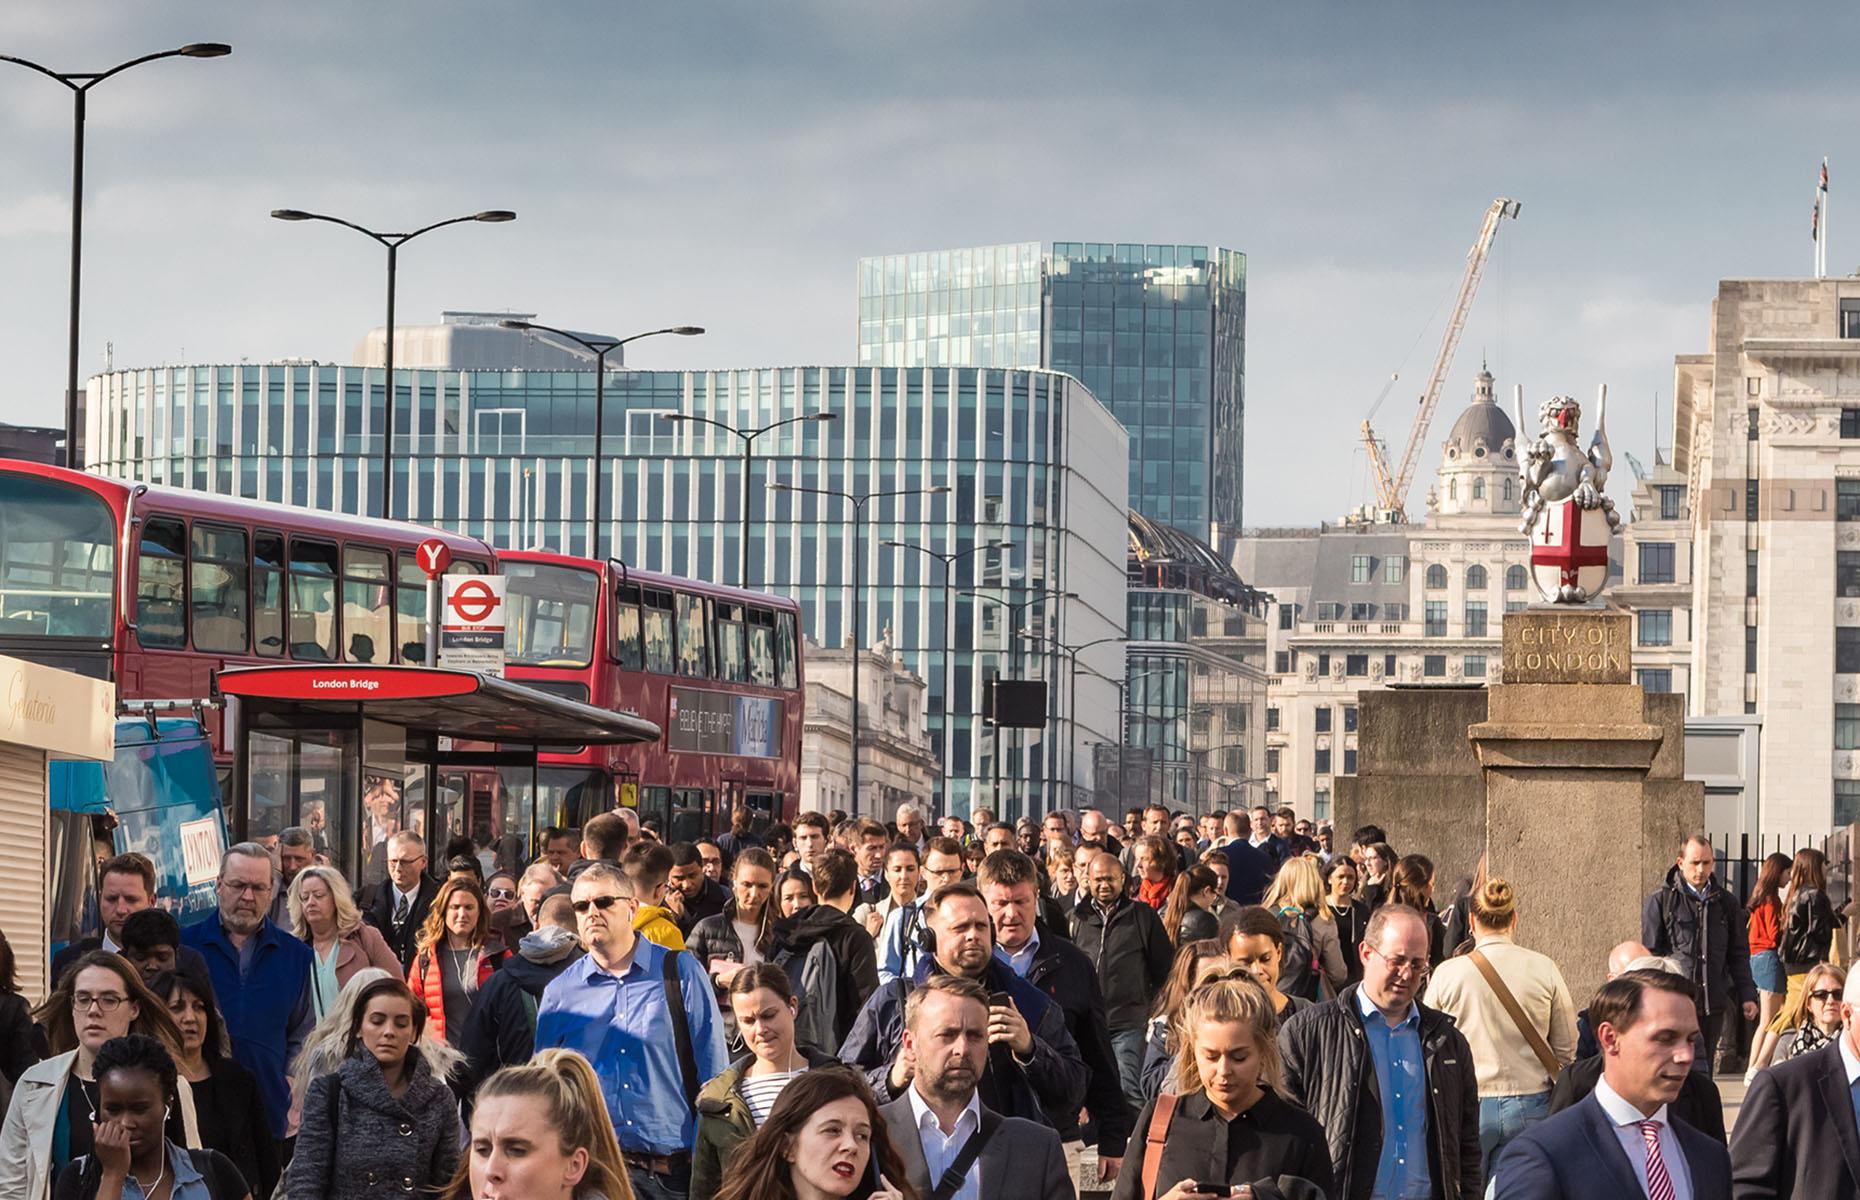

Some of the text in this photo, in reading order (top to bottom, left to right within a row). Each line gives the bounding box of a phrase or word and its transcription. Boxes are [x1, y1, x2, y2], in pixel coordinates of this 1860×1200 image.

[422, 544, 444, 570] Y
[475, 636, 493, 644] Bridge
[1522, 627, 1618, 645] CITY OF
[1514, 652, 1622, 671] LONDON
[312, 679, 379, 691] London Bridge
[8, 670, 57, 731] Gelateria
[183, 829, 219, 874] LYNTON
